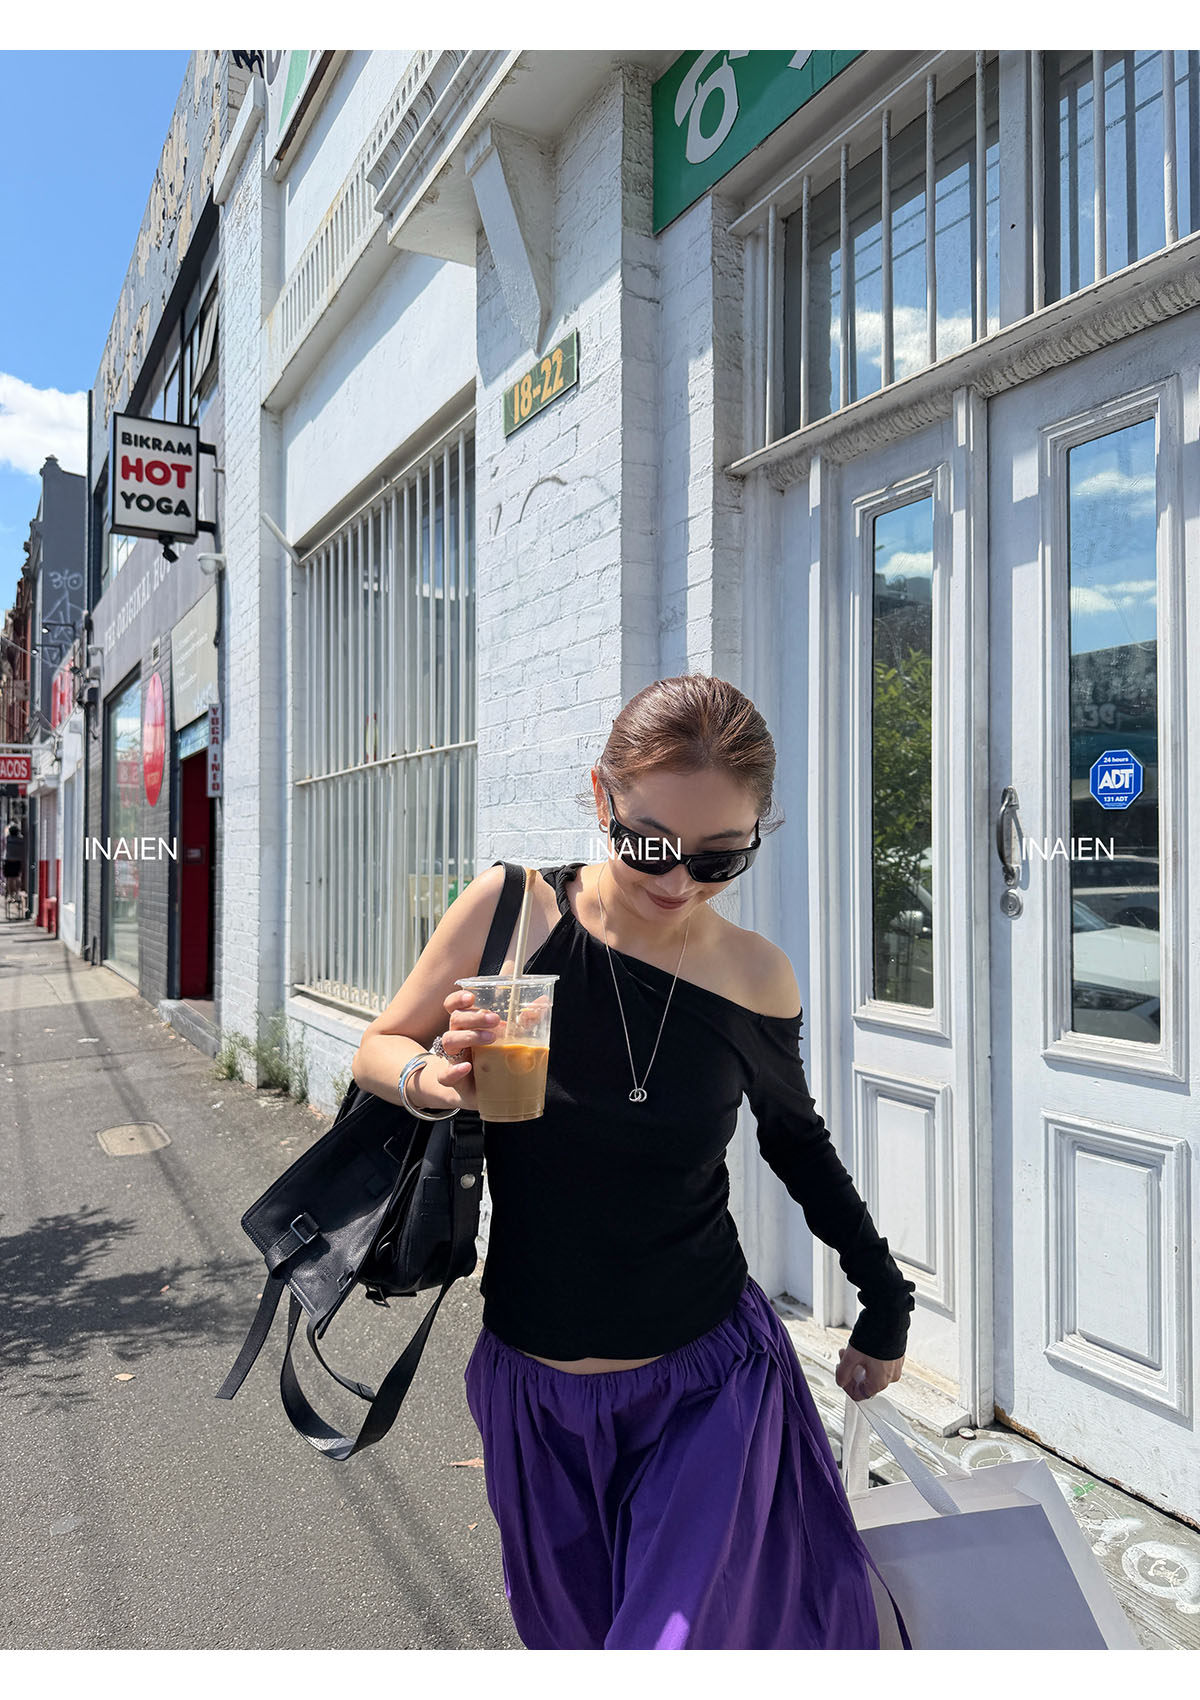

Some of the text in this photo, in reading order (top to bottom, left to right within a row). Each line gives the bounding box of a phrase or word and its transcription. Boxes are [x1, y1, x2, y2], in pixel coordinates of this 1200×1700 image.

[514, 348, 564, 425] 18-22
[121, 431, 193, 456] BIKRAM
[121, 455, 192, 489] HOT
[120, 490, 191, 518] YOGA
[211, 707, 220, 791] YOGA INFO
[0, 760, 28, 777] ACOS
[1099, 769, 1133, 789] ADT
